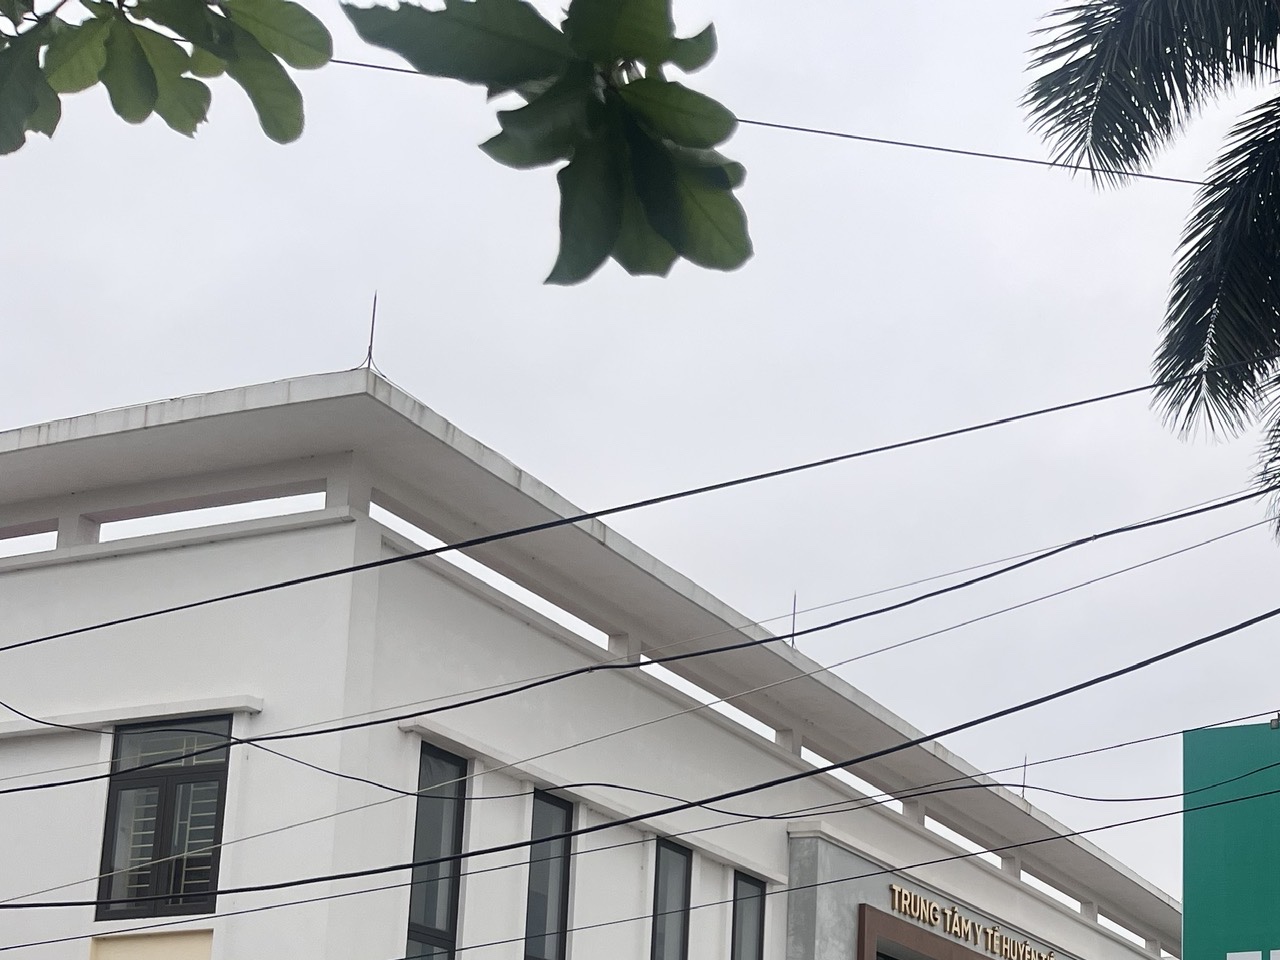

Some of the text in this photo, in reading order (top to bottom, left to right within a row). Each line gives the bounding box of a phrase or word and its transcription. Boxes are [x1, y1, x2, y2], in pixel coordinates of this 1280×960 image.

[889, 884, 941, 927] TRUNG
[942, 906, 972, 942] TÂM
[972, 922, 984, 946] Y
[984, 925, 1001, 955] TẾ
